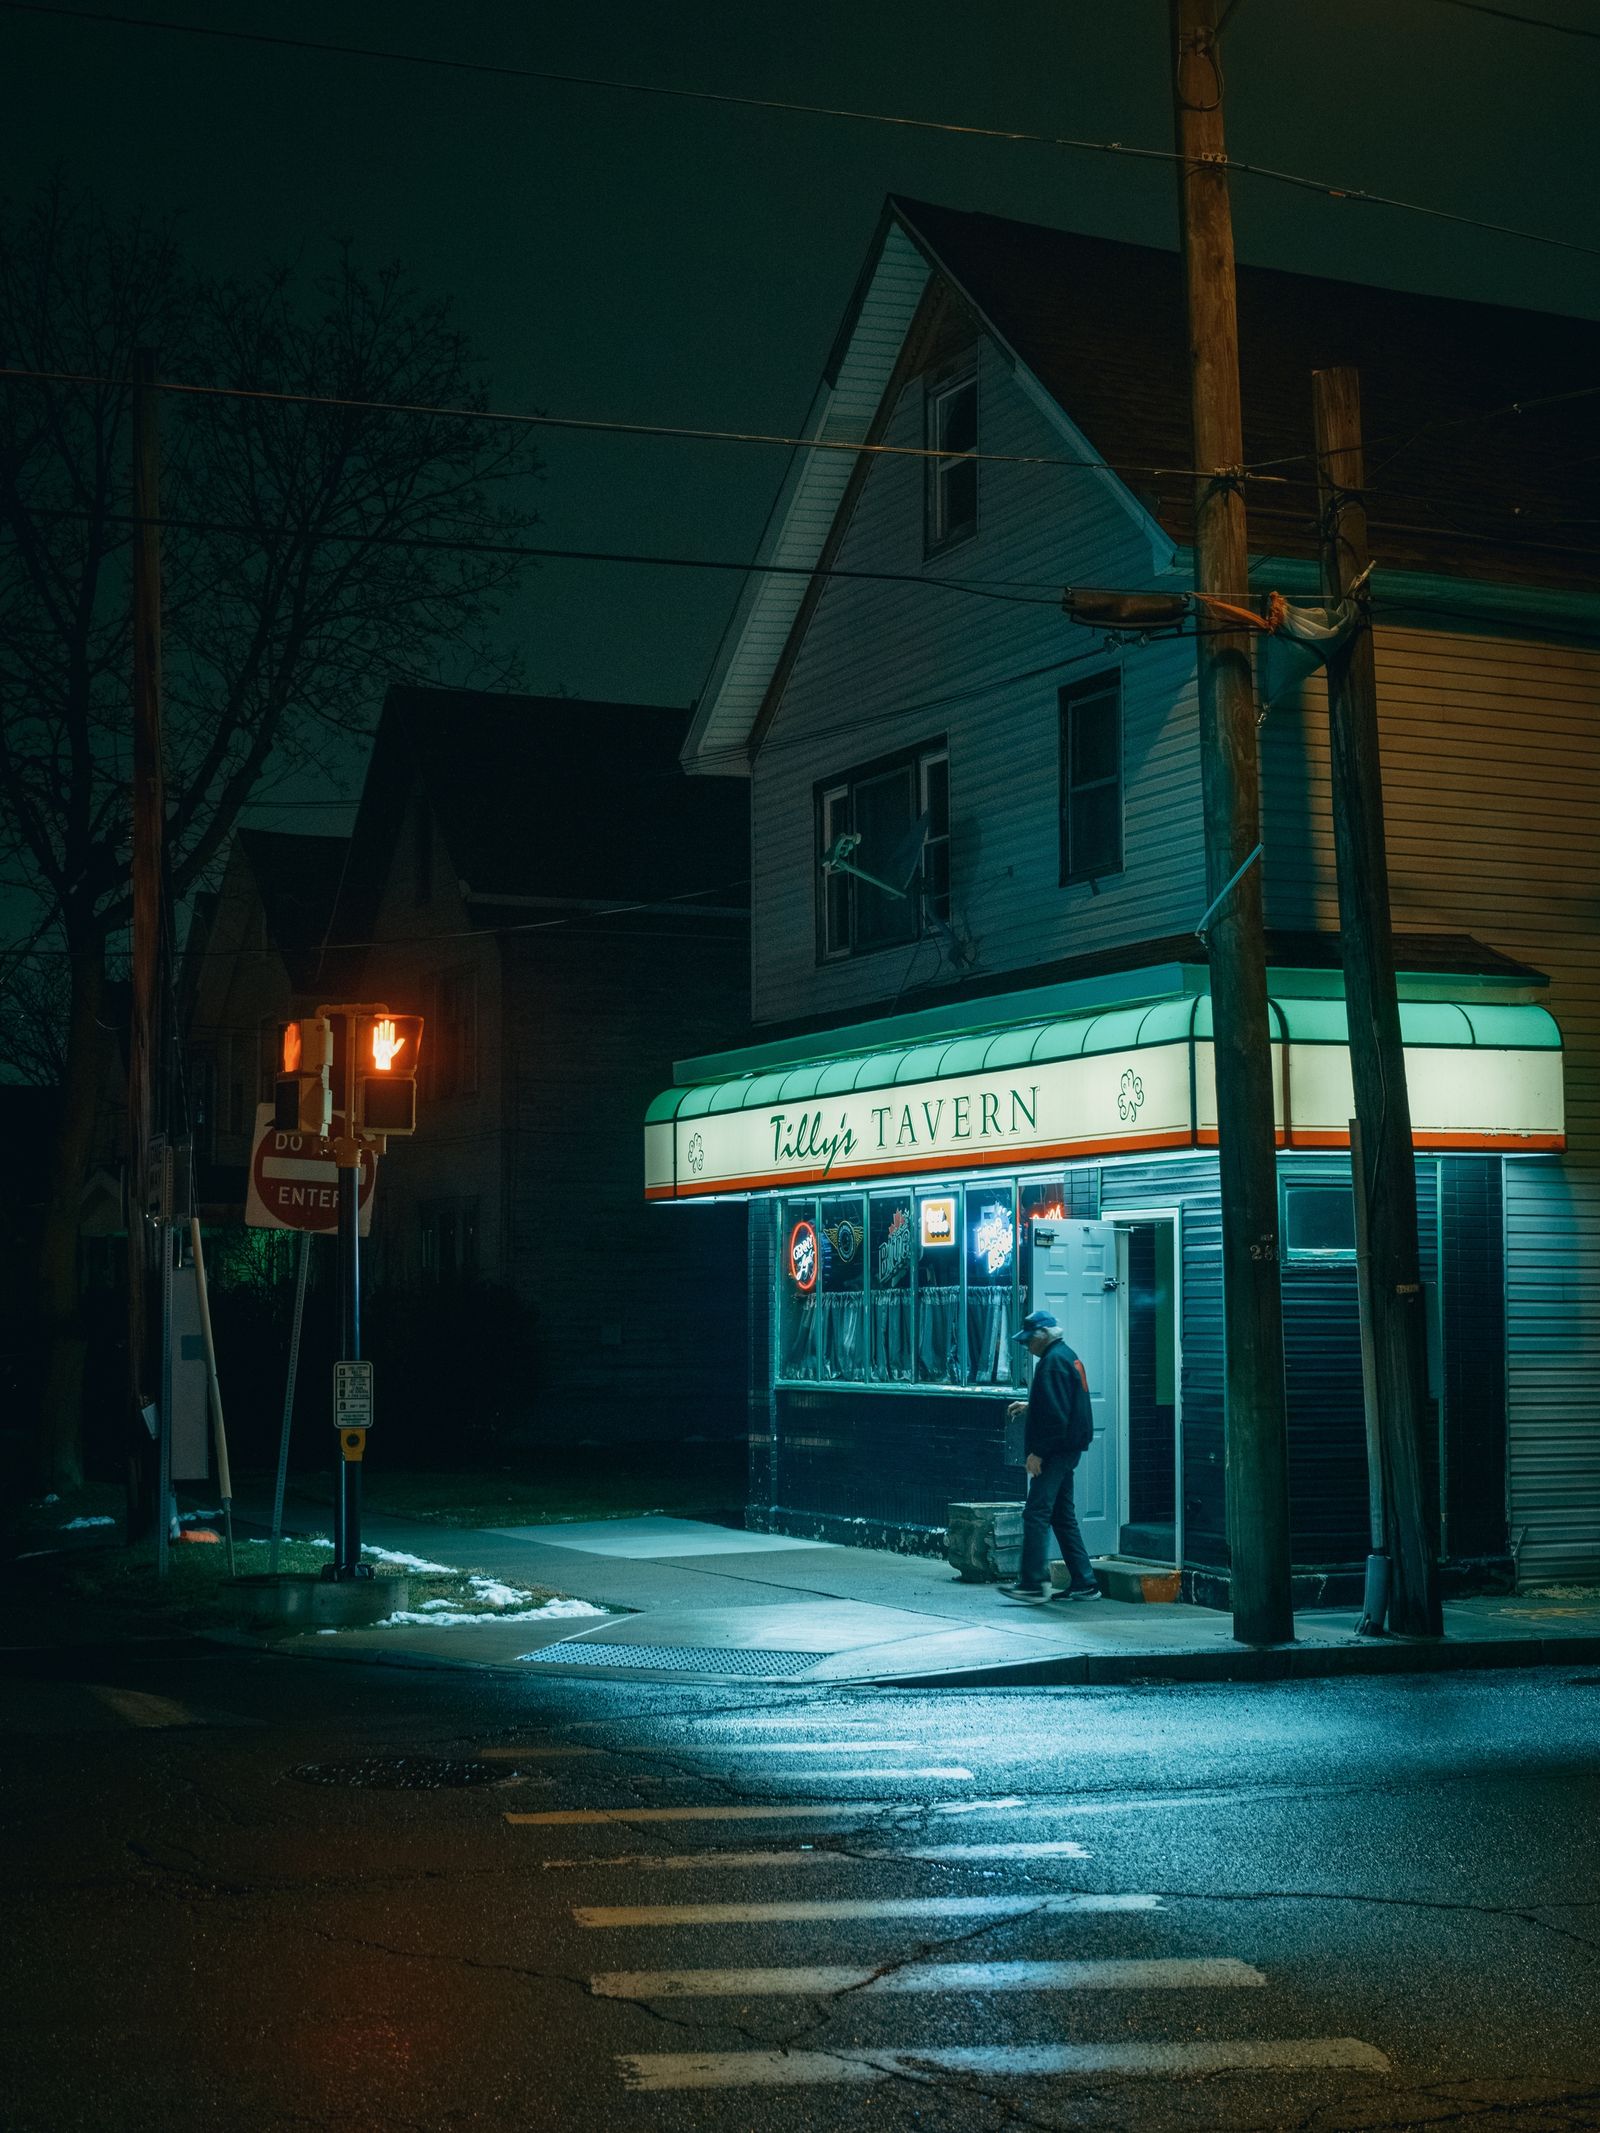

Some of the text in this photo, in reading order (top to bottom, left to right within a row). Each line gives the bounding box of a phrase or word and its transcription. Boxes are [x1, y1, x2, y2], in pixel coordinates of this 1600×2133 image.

[275, 1133, 303, 1151] DO
[770, 1086, 1040, 1176] Tilly's TAVERN
